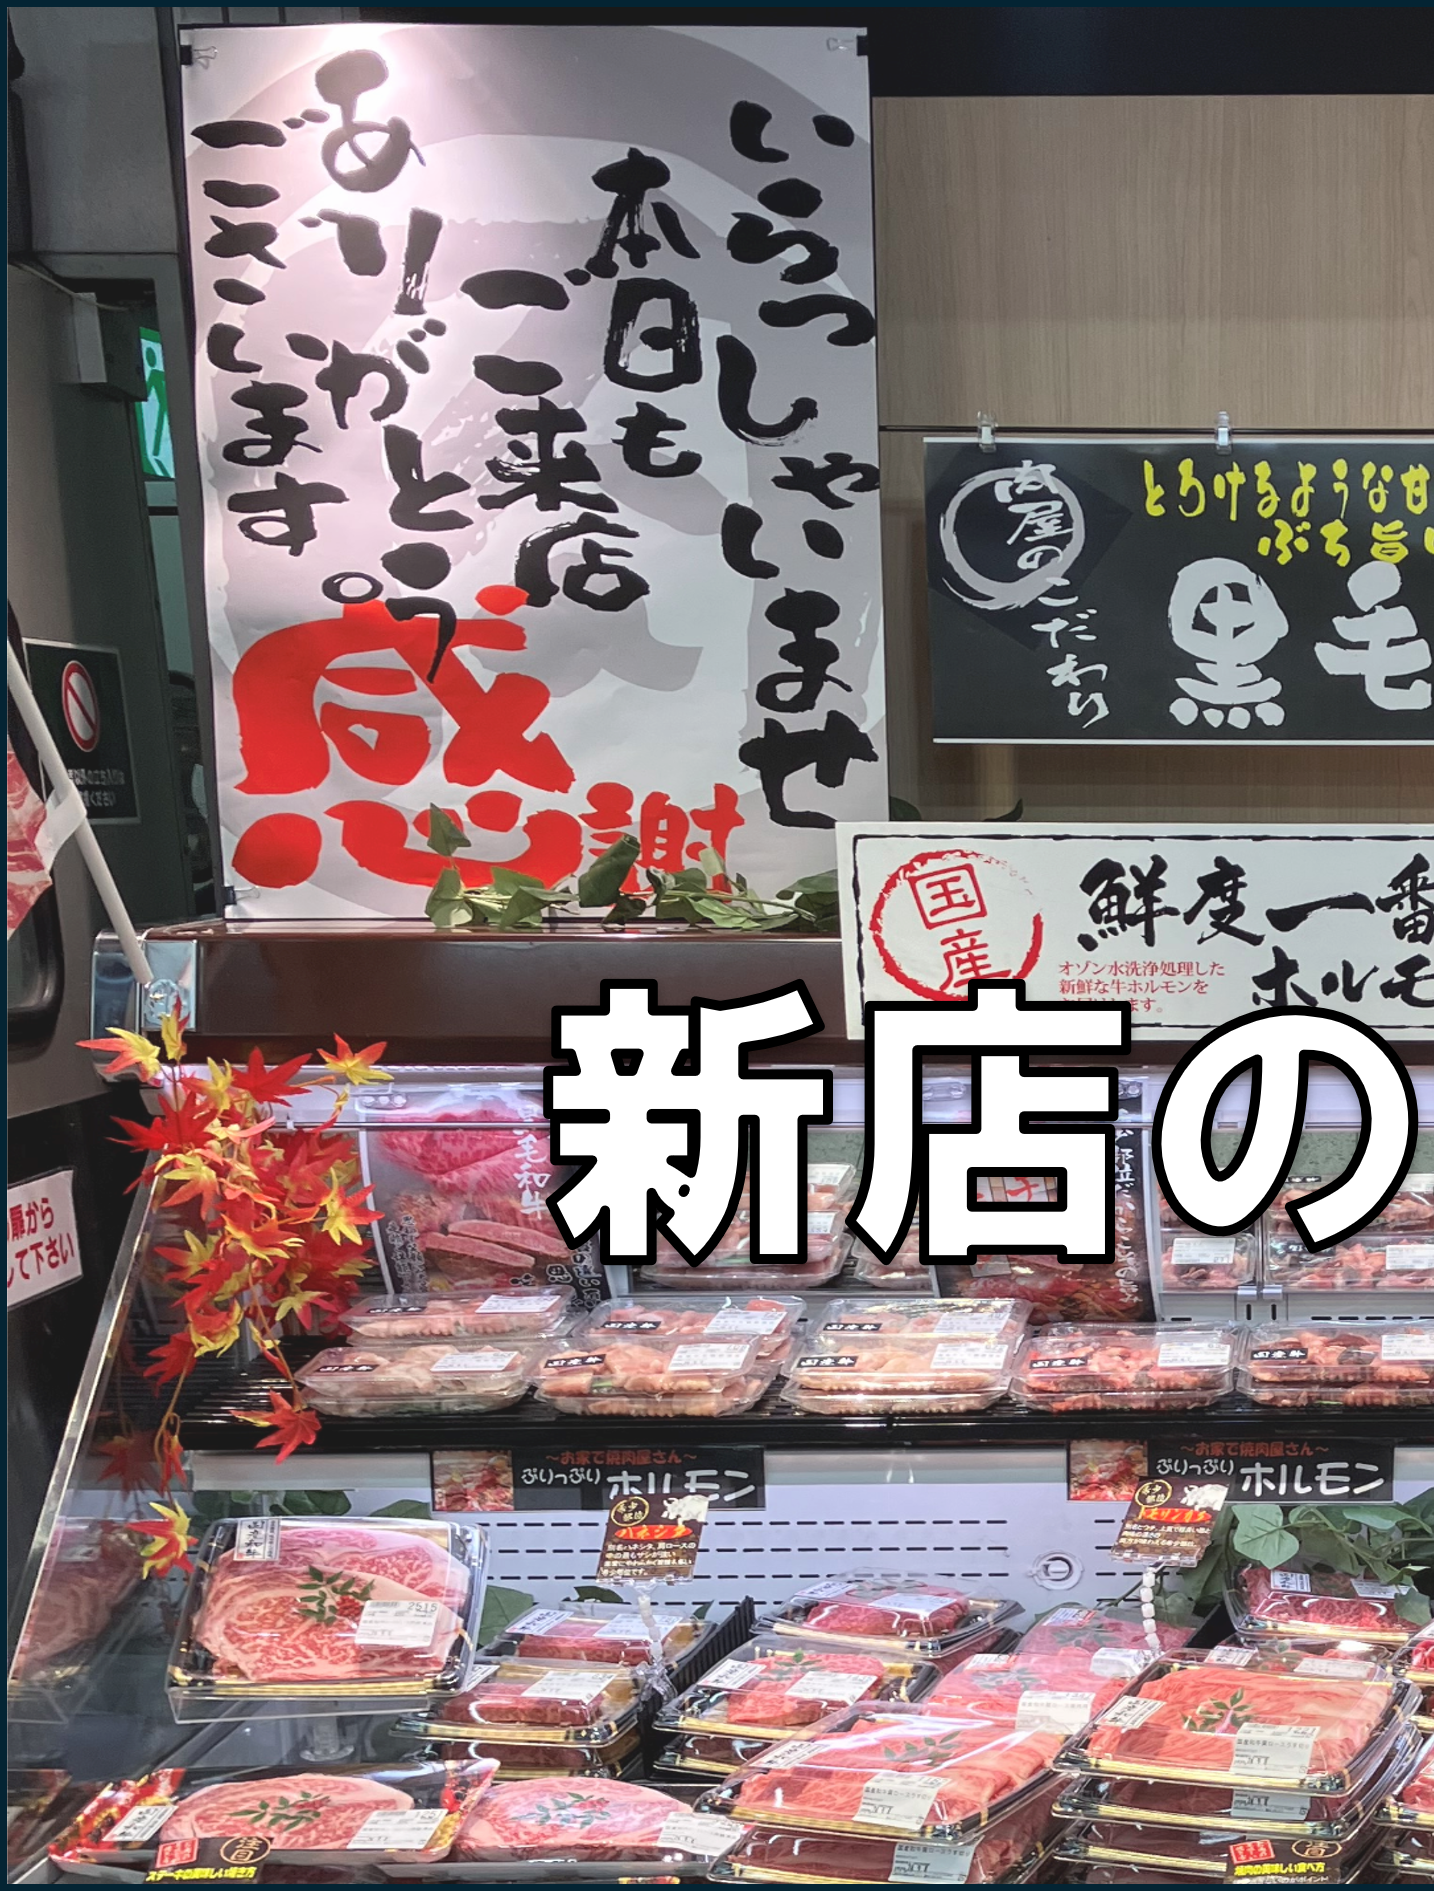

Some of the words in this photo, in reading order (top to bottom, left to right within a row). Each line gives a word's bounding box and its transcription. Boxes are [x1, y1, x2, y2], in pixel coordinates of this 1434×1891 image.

[314, 49, 472, 684] ありがとう
[460, 265, 651, 611] ご来店
[585, 147, 703, 478] 本日も
[716, 100, 881, 829] いらっしゃいませ
[992, 458, 1112, 729] 肉屋のこだわり
[231, 583, 745, 894] 感謝
[907, 862, 1013, 993] 国産
[1058, 959, 1226, 977] オゾン水洗浄処理した
[1058, 979, 1209, 995] 新鮮な牛ホルモンを
[521, 1467, 600, 1485] ぷりっぷり
[606, 1469, 756, 1501] ホルモン
[1156, 1458, 1235, 1475] ぷりっぷり
[1240, 1461, 1385, 1498] ホルモン
